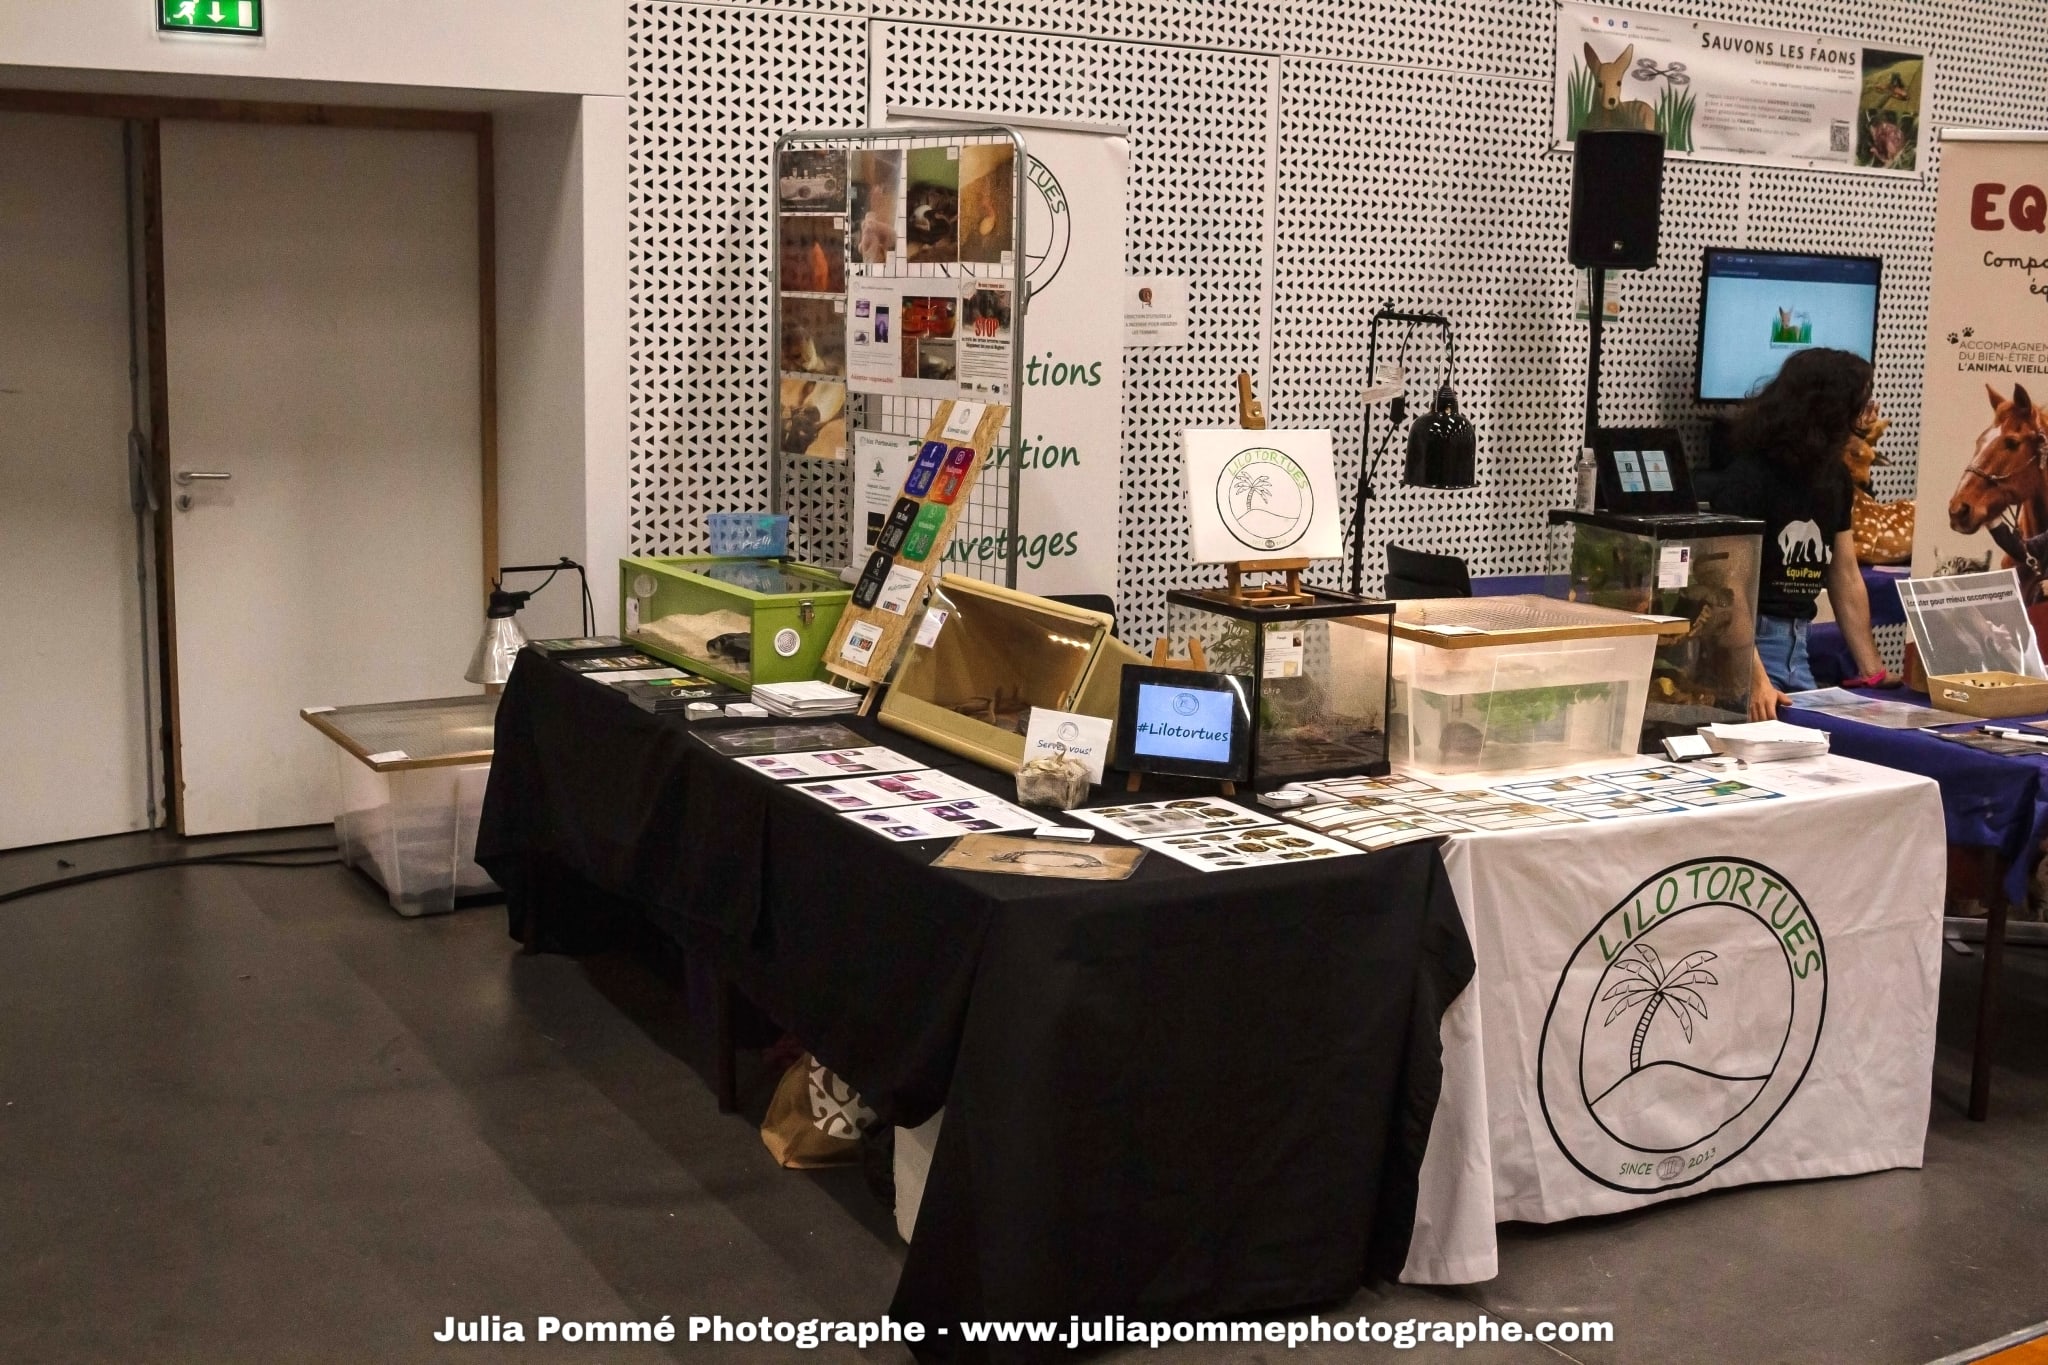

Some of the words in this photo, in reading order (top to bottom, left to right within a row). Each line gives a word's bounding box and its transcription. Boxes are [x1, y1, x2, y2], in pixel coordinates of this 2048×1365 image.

[1701, 32, 1774, 56] SAUVONS
[1779, 44, 1805, 60] LES
[1810, 47, 1857, 66] FAONS
[974, 317, 999, 338] STOP
[1959, 351, 1976, 361] DU
[1958, 362, 2013, 373] L'ANIMAL
[1255, 450, 1309, 491] TORTUES
[1929, 597, 1945, 608] pour
[1946, 594, 1966, 604] mieux
[1966, 589, 2013, 602] accompagner
[1137, 722, 1229, 742] #Lilotortues
[1686, 866, 1821, 979] TORTUES
[1619, 1162, 1655, 1175] SINCE
[1687, 1147, 1716, 1169] 2013
